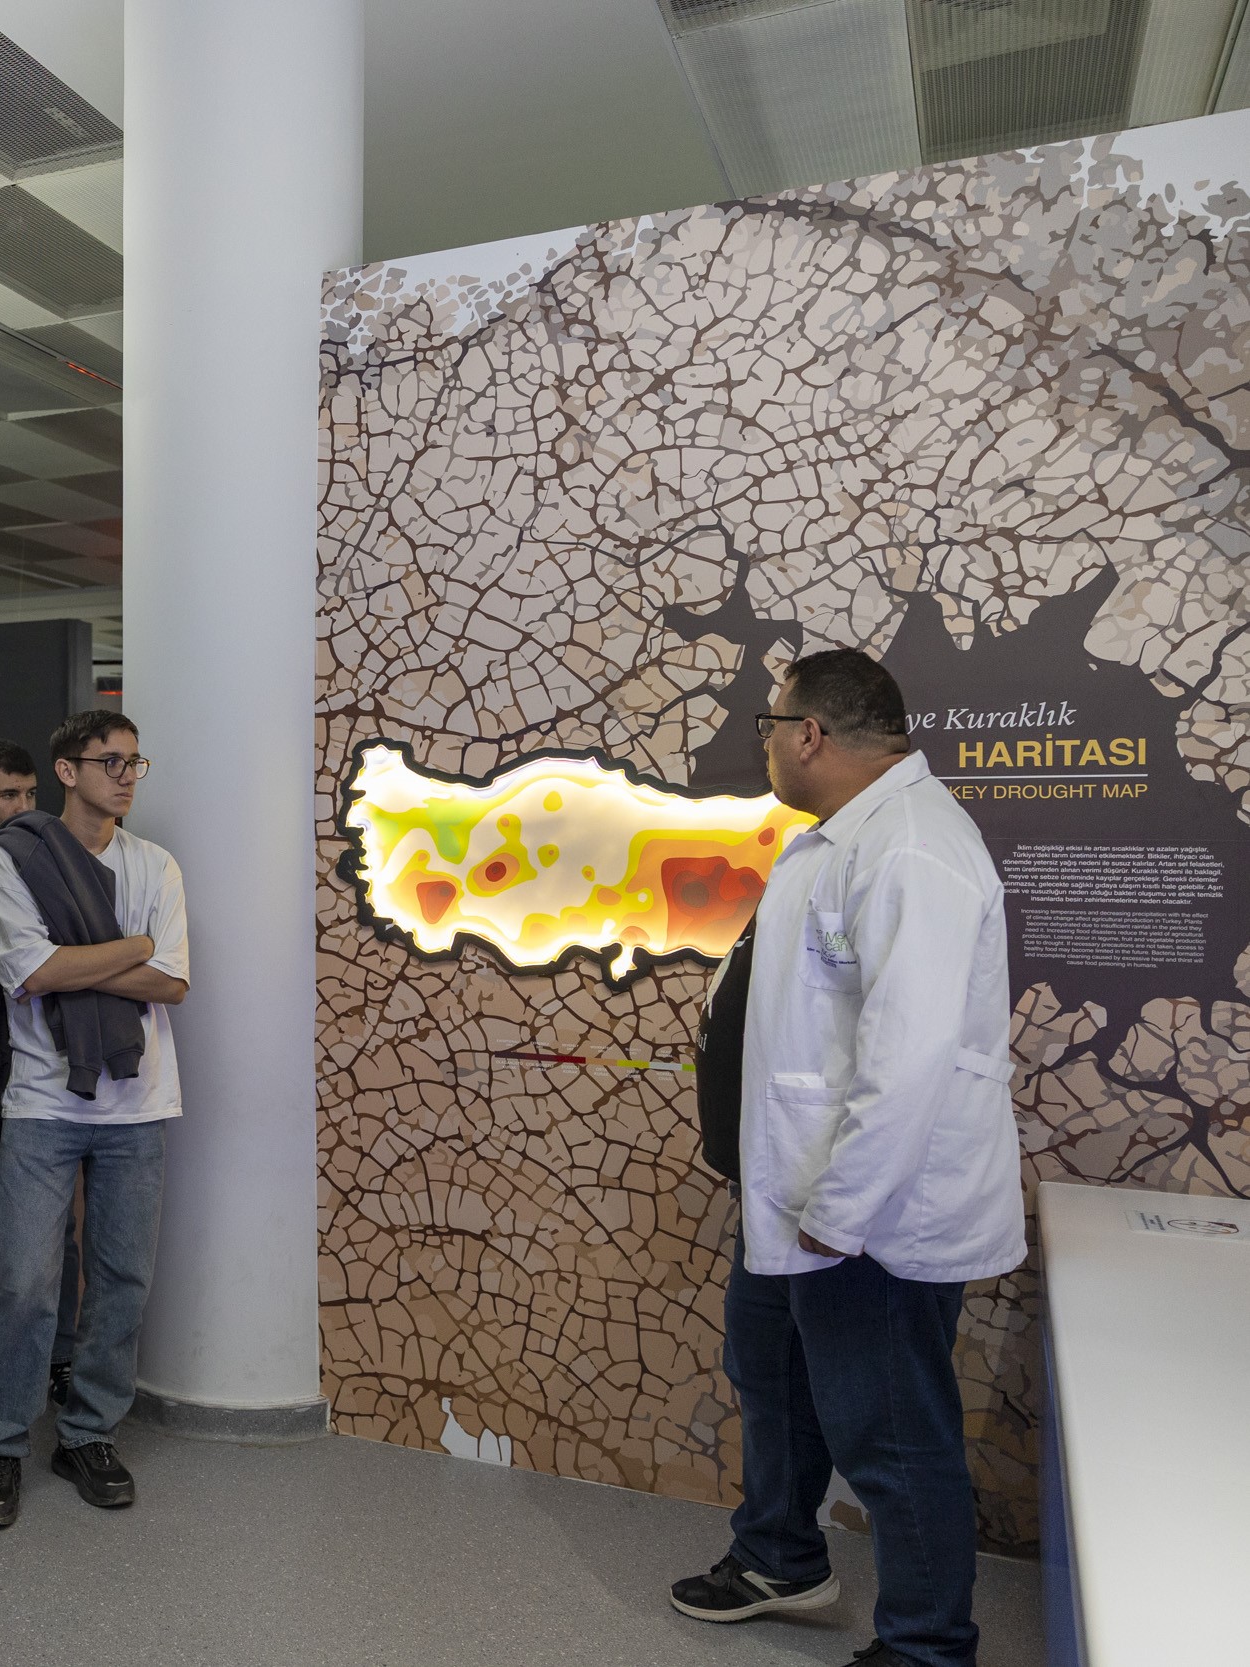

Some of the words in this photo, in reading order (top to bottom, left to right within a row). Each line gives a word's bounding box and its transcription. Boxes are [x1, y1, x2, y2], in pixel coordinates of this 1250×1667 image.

[905, 712, 937, 735] ye
[943, 701, 1077, 730] Kuraklık
[958, 733, 1147, 768] HARİTASI
[949, 785, 988, 800] KEY
[993, 784, 1097, 800] DROUGHT
[1103, 784, 1148, 799] MAP
[1013, 852, 1050, 860] Türkiye'deki
[1033, 859, 1058, 867] yetersiz
[1096, 875, 1122, 883] kayıplar
[1038, 881, 1070, 890] gelecekte
[1070, 882, 1094, 890] sağlıklı
[1094, 882, 1118, 890] gıdaya
[1118, 883, 1141, 891] ulaşım
[1207, 884, 1224, 892] Aşırı
[1030, 888, 1067, 897] susuzluğun
[1090, 889, 1113, 897] olduğu
[1137, 890, 1167, 898] oluşumu
